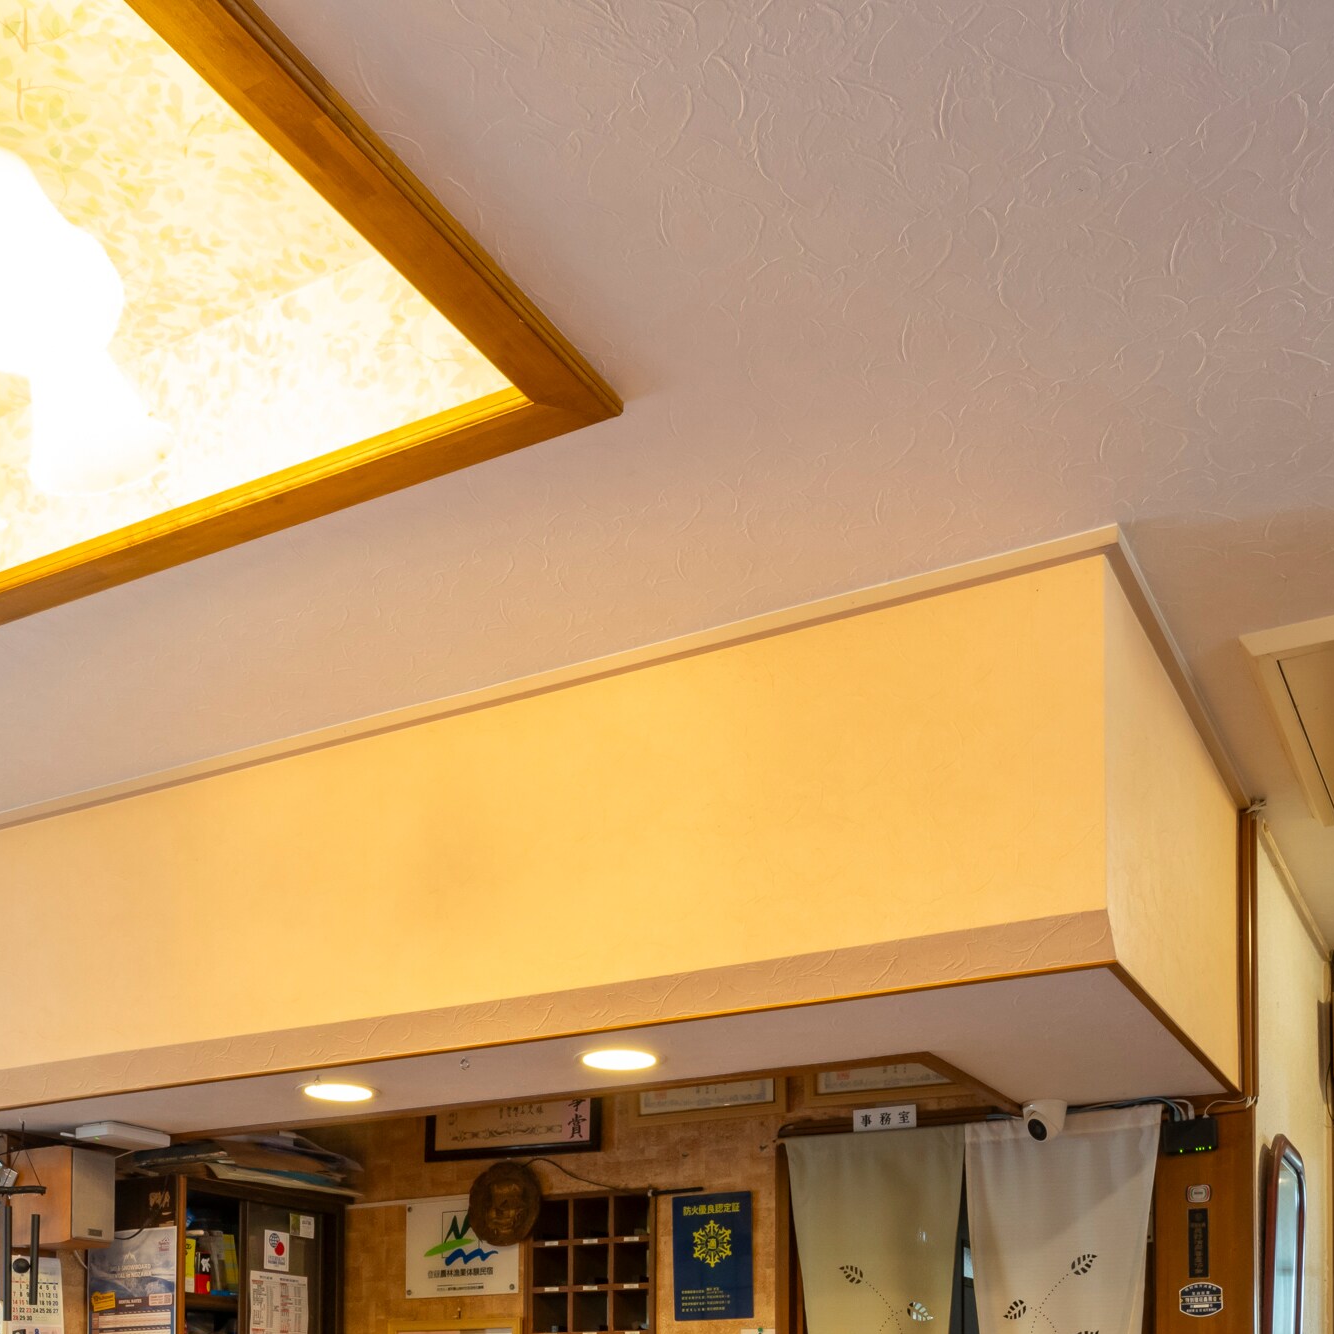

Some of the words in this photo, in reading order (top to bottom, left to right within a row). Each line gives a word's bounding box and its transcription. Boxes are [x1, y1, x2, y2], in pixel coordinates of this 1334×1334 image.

[859, 1110, 911, 1127] 事務室
[683, 1202, 740, 1216] 防火優良認定証
